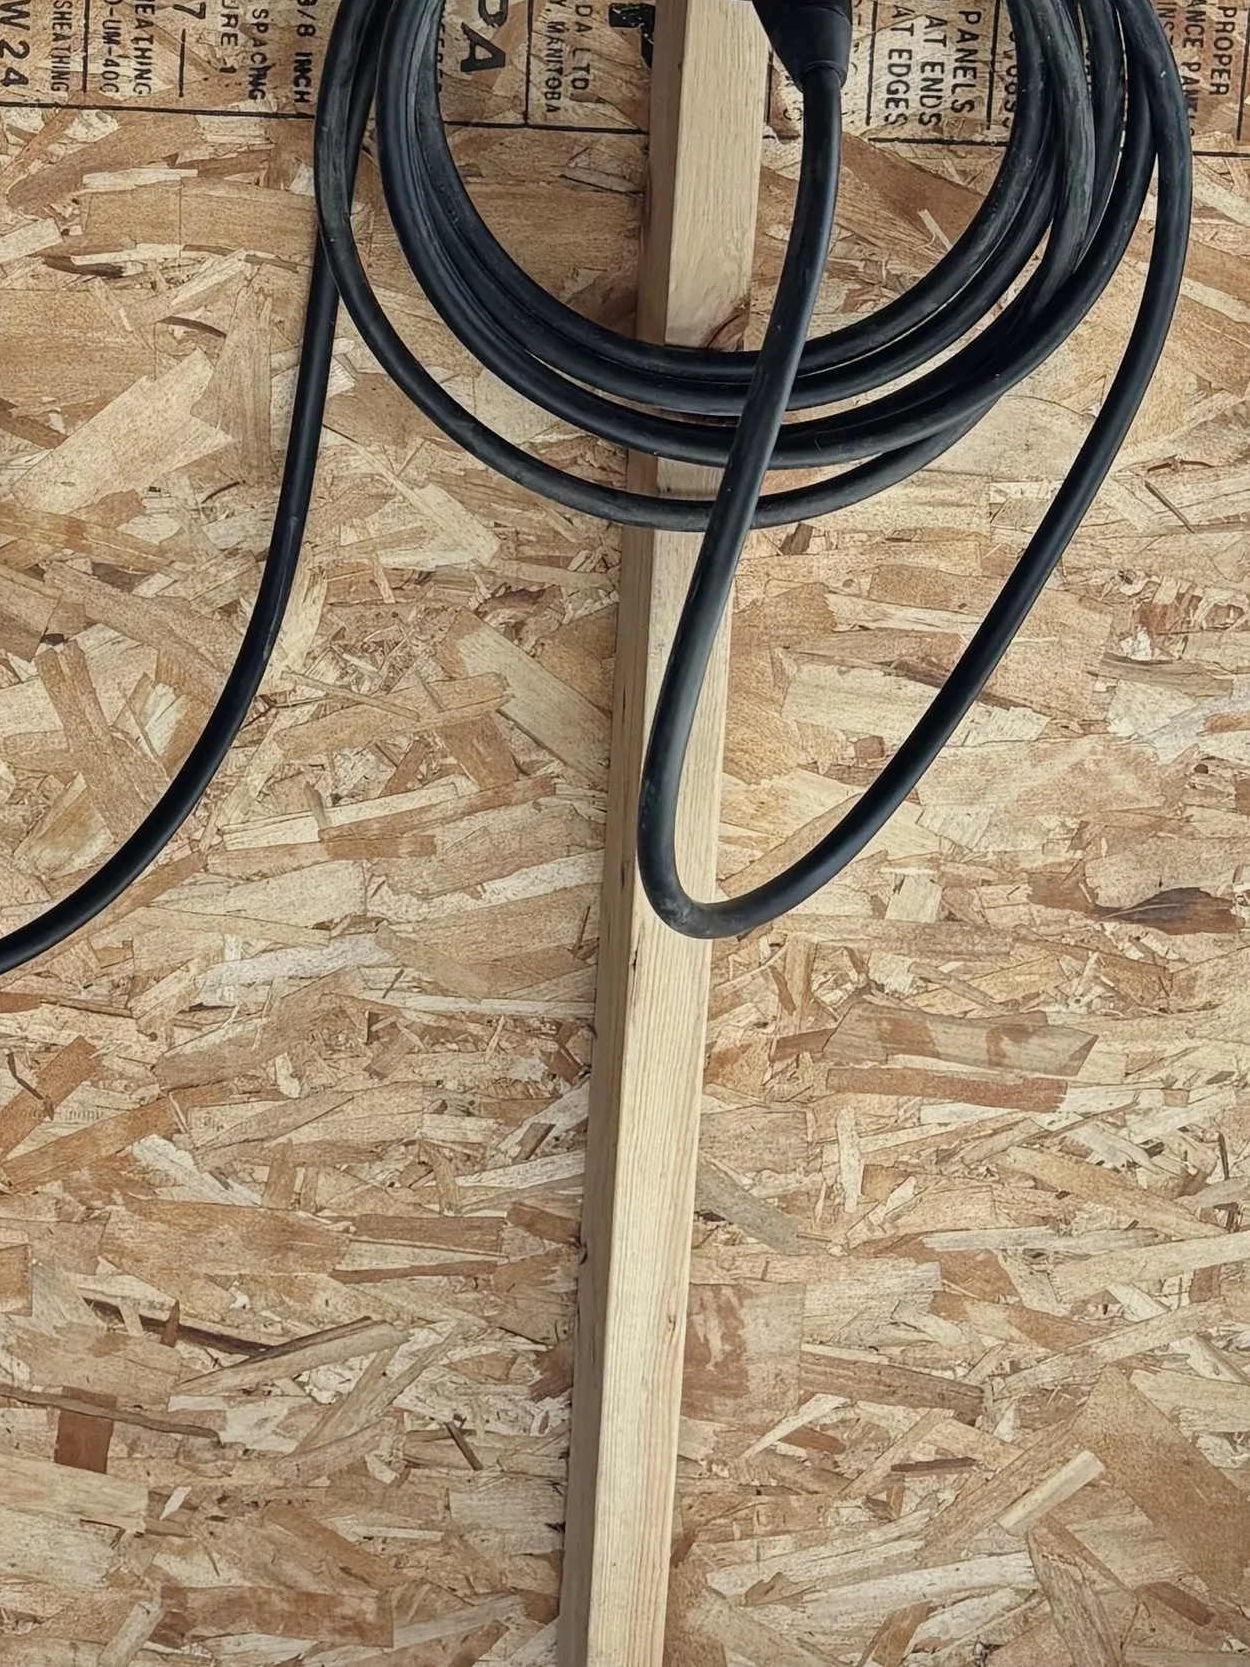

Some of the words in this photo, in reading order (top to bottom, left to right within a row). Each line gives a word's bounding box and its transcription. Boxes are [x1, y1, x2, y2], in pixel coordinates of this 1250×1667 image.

[50, 0, 73, 93] SHEATHING
[248, 8, 272, 101] SPACING
[891, 4, 916, 36] AT
[923, 15, 947, 48] AT
[950, 10, 982, 113] PANELS
[1208, 6, 1238, 96] PROPER
[293, 51, 314, 104] INCH
[543, 20, 566, 115] MANITOBA
[883, 47, 913, 126] EDGES
[918, 61, 946, 126] ENDS
